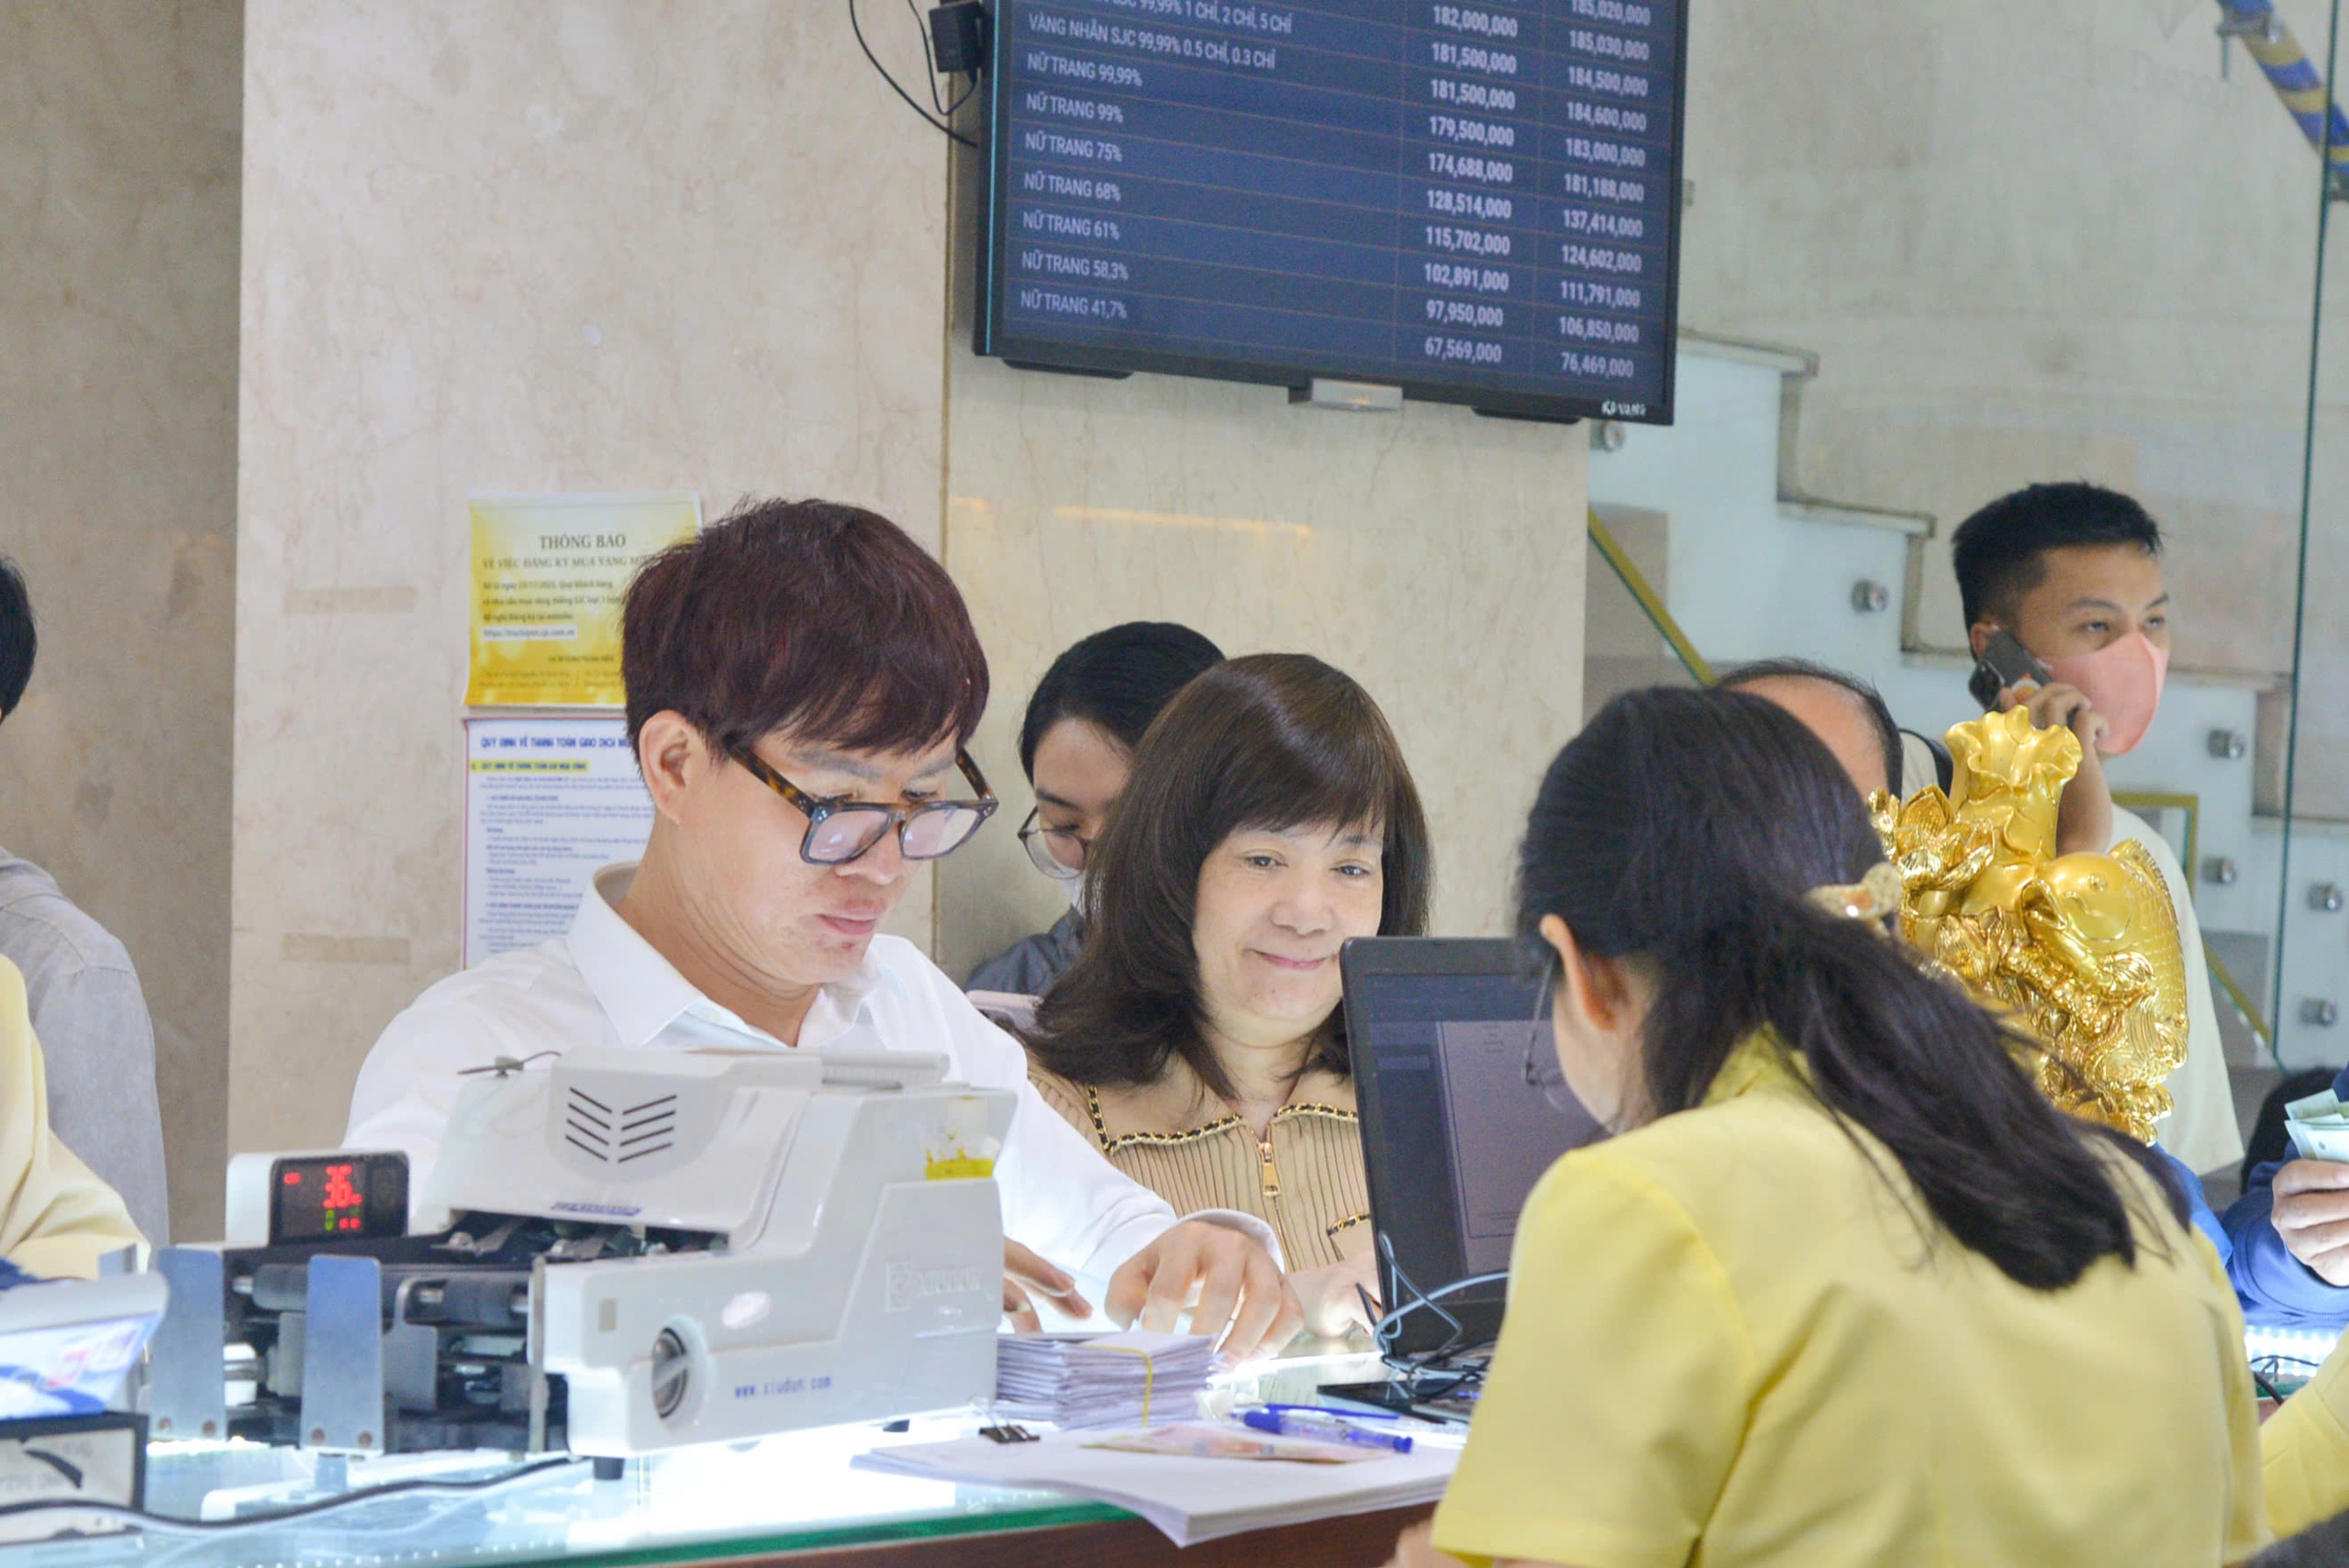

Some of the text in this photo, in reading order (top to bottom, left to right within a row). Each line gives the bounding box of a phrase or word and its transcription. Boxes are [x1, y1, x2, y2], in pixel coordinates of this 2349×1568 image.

[1222, 6, 1230, 25] 2
[1260, 12, 1268, 30] 5
[1433, 6, 1518, 38] 182,000,000
[1029, 11, 1065, 36] VÀNG
[1111, 27, 1136, 47] SJC
[1138, 31, 1181, 54] 99,99%
[1050, 56, 1095, 80] TRANG
[1432, 42, 1517, 74] 181,500,000
[1431, 79, 1515, 110] 181,500,000
[1050, 96, 1094, 120] TRANG
[1097, 103, 1123, 124] 99%
[1430, 116, 1514, 147] 179,500,000
[1049, 136, 1093, 158] TRANG
[1096, 141, 1122, 162] 75%
[1047, 175, 1092, 198] TRANG
[1095, 182, 1121, 202] 68%
[1427, 189, 1512, 219] 128,514,000
[1046, 215, 1091, 237] TRANG
[1094, 219, 1120, 240] 61%
[1564, 209, 1642, 239] 137,414,000
[1426, 226, 1510, 256] 115,702,000
[1045, 254, 1090, 276] TRANG
[1425, 262, 1509, 292] 102,891,000
[1044, 294, 1088, 316] TRANG
[1561, 281, 1640, 308] 111,791,000
[1426, 299, 1503, 328] 97,950,000
[1560, 316, 1639, 343] 106,850,000
[1425, 337, 1502, 364] 67,569,000
[1562, 351, 1633, 378] 76,469,000
